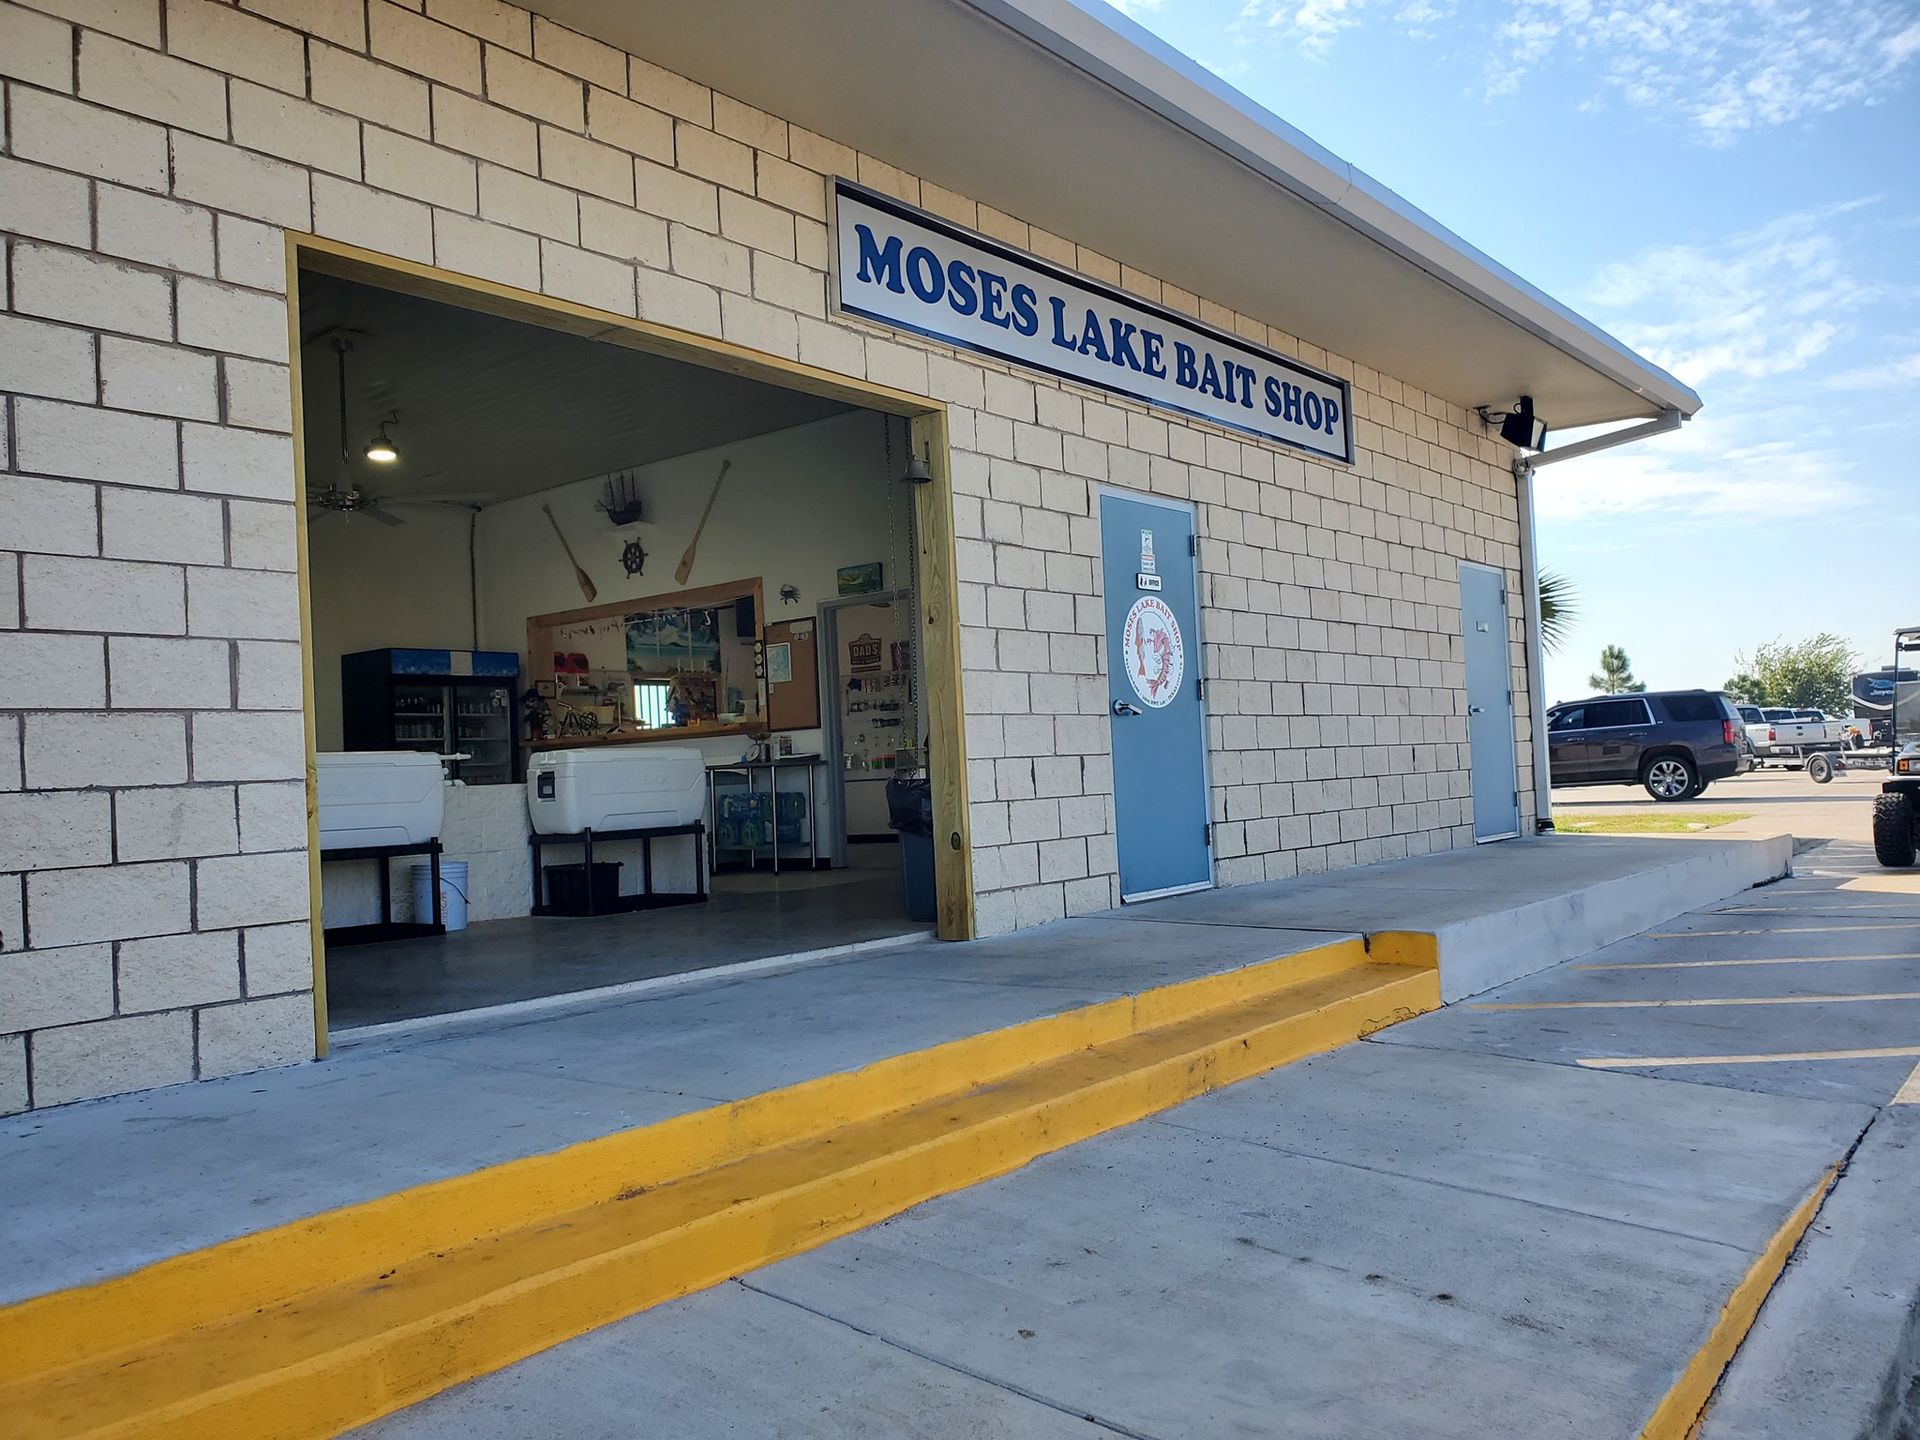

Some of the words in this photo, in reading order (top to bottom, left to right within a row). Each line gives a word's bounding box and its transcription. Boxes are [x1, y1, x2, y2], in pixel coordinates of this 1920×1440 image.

[854, 223, 1039, 337] MOSES
[1049, 295, 1167, 380] LAKE
[1173, 340, 1257, 409] BAIT
[1264, 375, 1340, 435] SHOP
[852, 644, 878, 657] DADS
[1125, 611, 1137, 648] MOSES
[1136, 599, 1155, 613] LAKE
[1155, 600, 1172, 620] BAIT
[1171, 621, 1182, 651] SHOP
